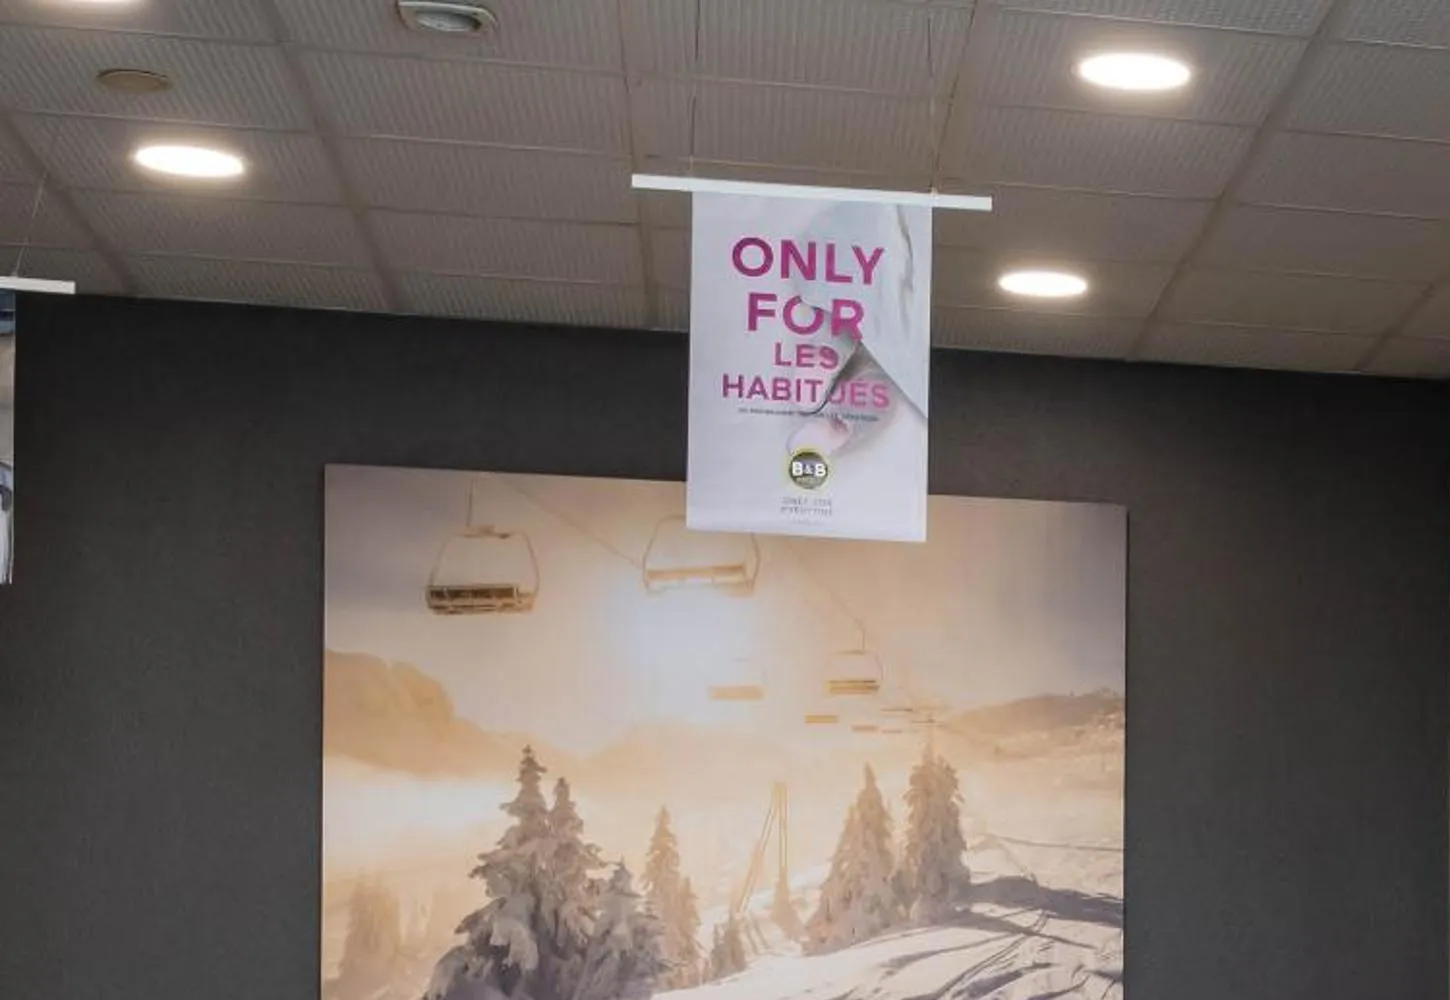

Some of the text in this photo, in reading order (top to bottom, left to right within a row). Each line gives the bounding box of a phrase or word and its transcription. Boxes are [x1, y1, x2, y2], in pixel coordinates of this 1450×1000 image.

[731, 236, 885, 286] ONLY
[747, 292, 865, 341] FOR
[774, 341, 840, 370] LES
[792, 461, 826, 477] B&B
